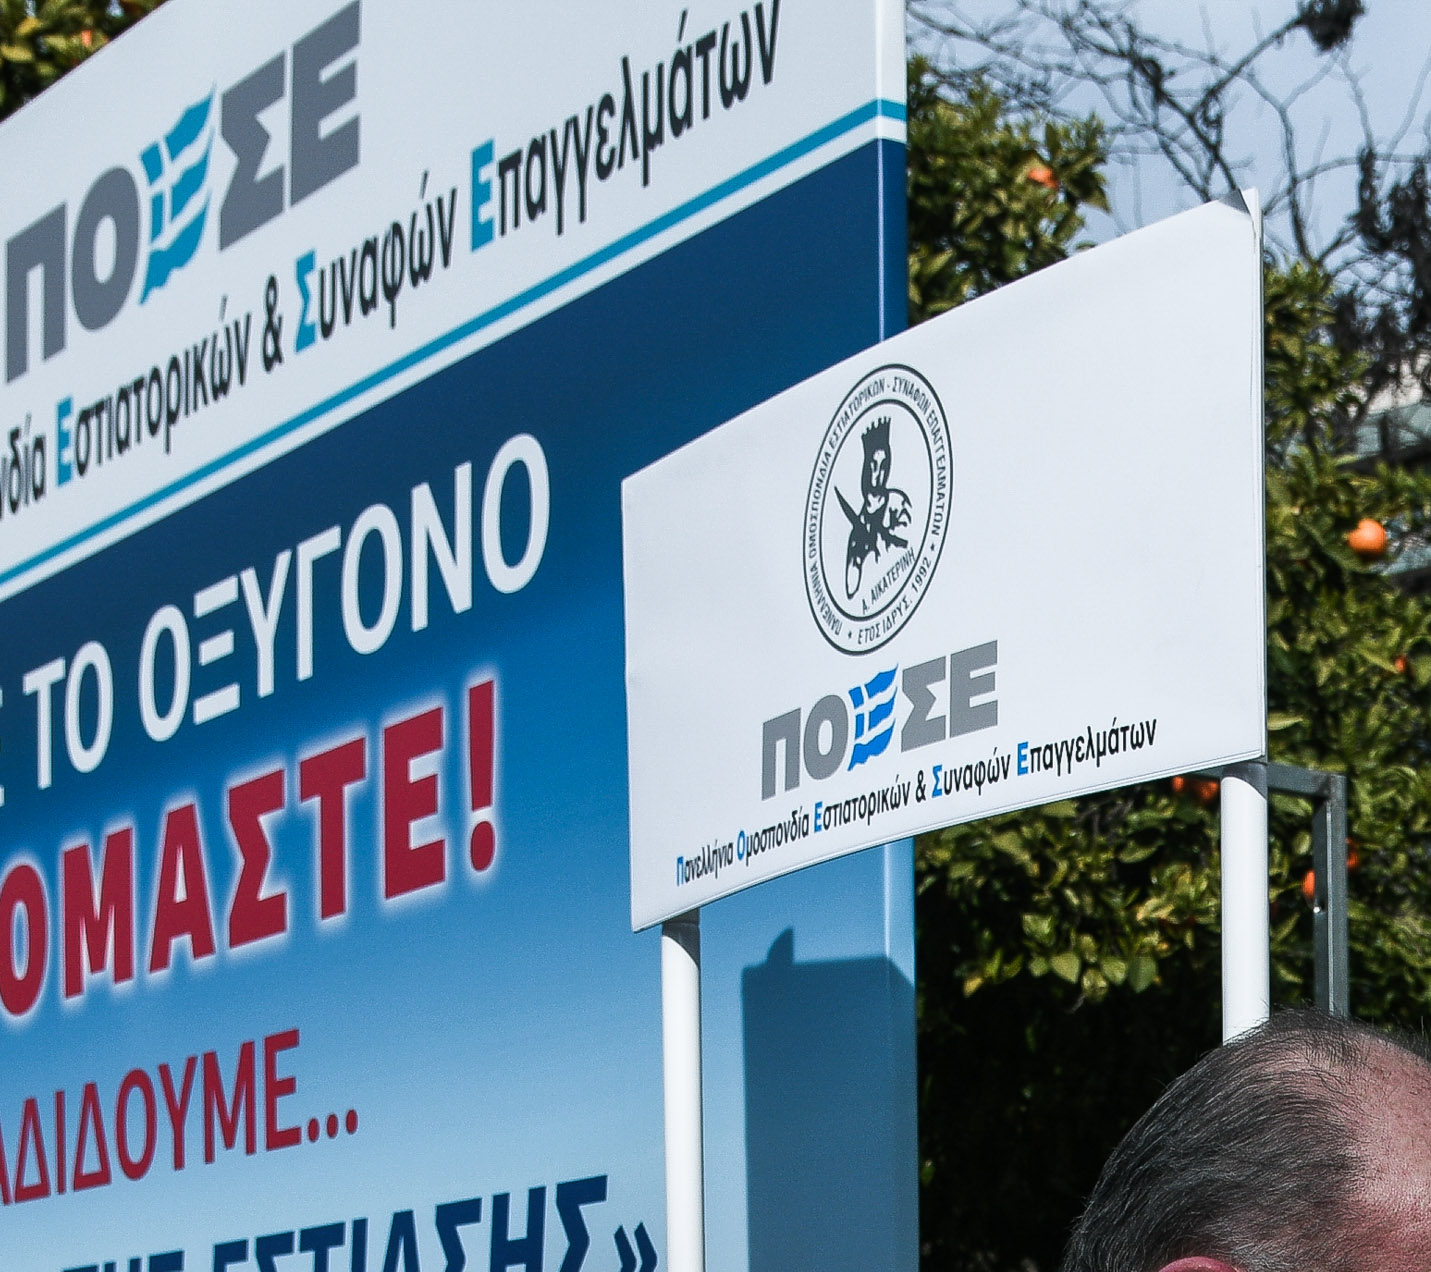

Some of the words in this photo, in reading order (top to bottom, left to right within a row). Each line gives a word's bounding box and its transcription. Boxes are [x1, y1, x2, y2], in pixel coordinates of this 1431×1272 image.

[6, 0, 361, 384] ΠΟΕΣΕ
[57, 296, 252, 487] Εστιατορικών
[262, 275, 283, 373] &
[294, 170, 458, 354] Συναφών
[471, 2, 780, 252] Επαγγελμάτων
[23, 640, 114, 790] ΤΟ
[139, 433, 551, 742] ΟΞΥΓΟΝΟ
[858, 623, 881, 645] ΕΤΟΣ
[911, 556, 932, 593] 1992
[870, 547, 916, 602] ΑΙΚΑΤΕΡΙΝΗ
[676, 839, 734, 887] Πανελλήνια
[737, 806, 810, 867] Ομοσπονδία
[814, 774, 910, 833] Εστιατορικών
[915, 770, 927, 803] &
[932, 747, 1010, 798] Συναφών
[1017, 717, 1157, 777] Επαγγελμάτων
[761, 640, 998, 801] ΠΟΕΣΕ
